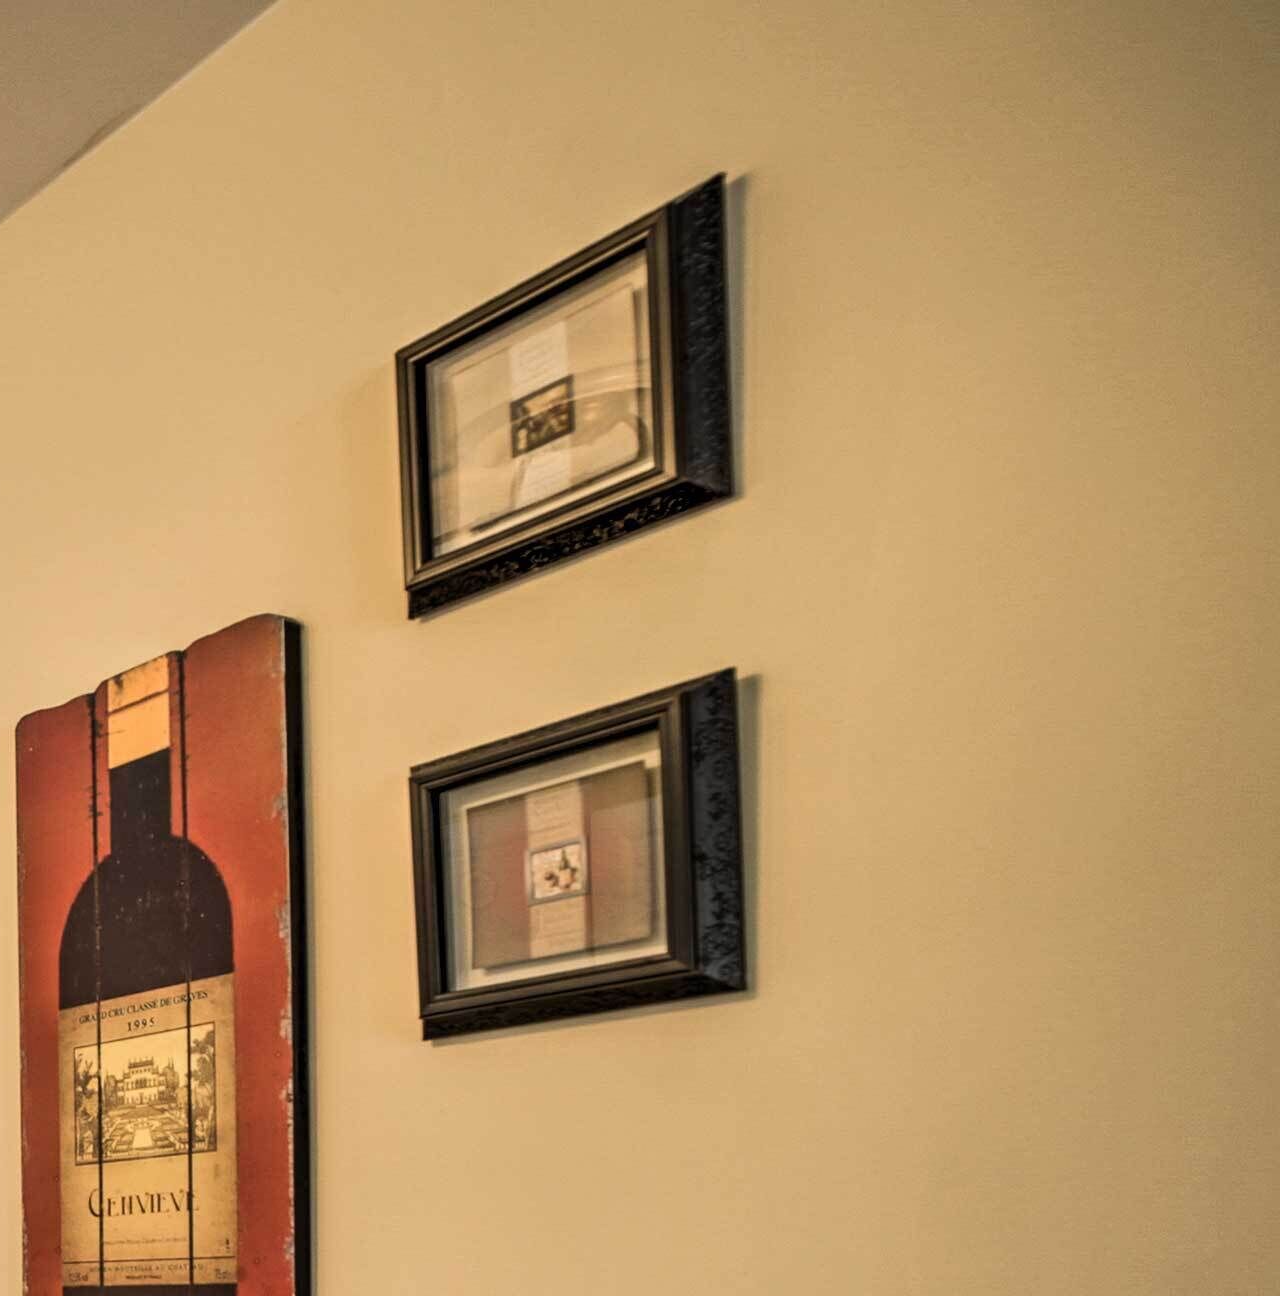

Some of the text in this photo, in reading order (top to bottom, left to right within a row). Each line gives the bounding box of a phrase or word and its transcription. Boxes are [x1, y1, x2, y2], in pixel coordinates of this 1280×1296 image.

[79, 1010, 107, 1025] GRAD
[108, 1006, 126, 1018] CRU
[160, 996, 173, 1008] DE
[127, 1016, 156, 1032] 1995
